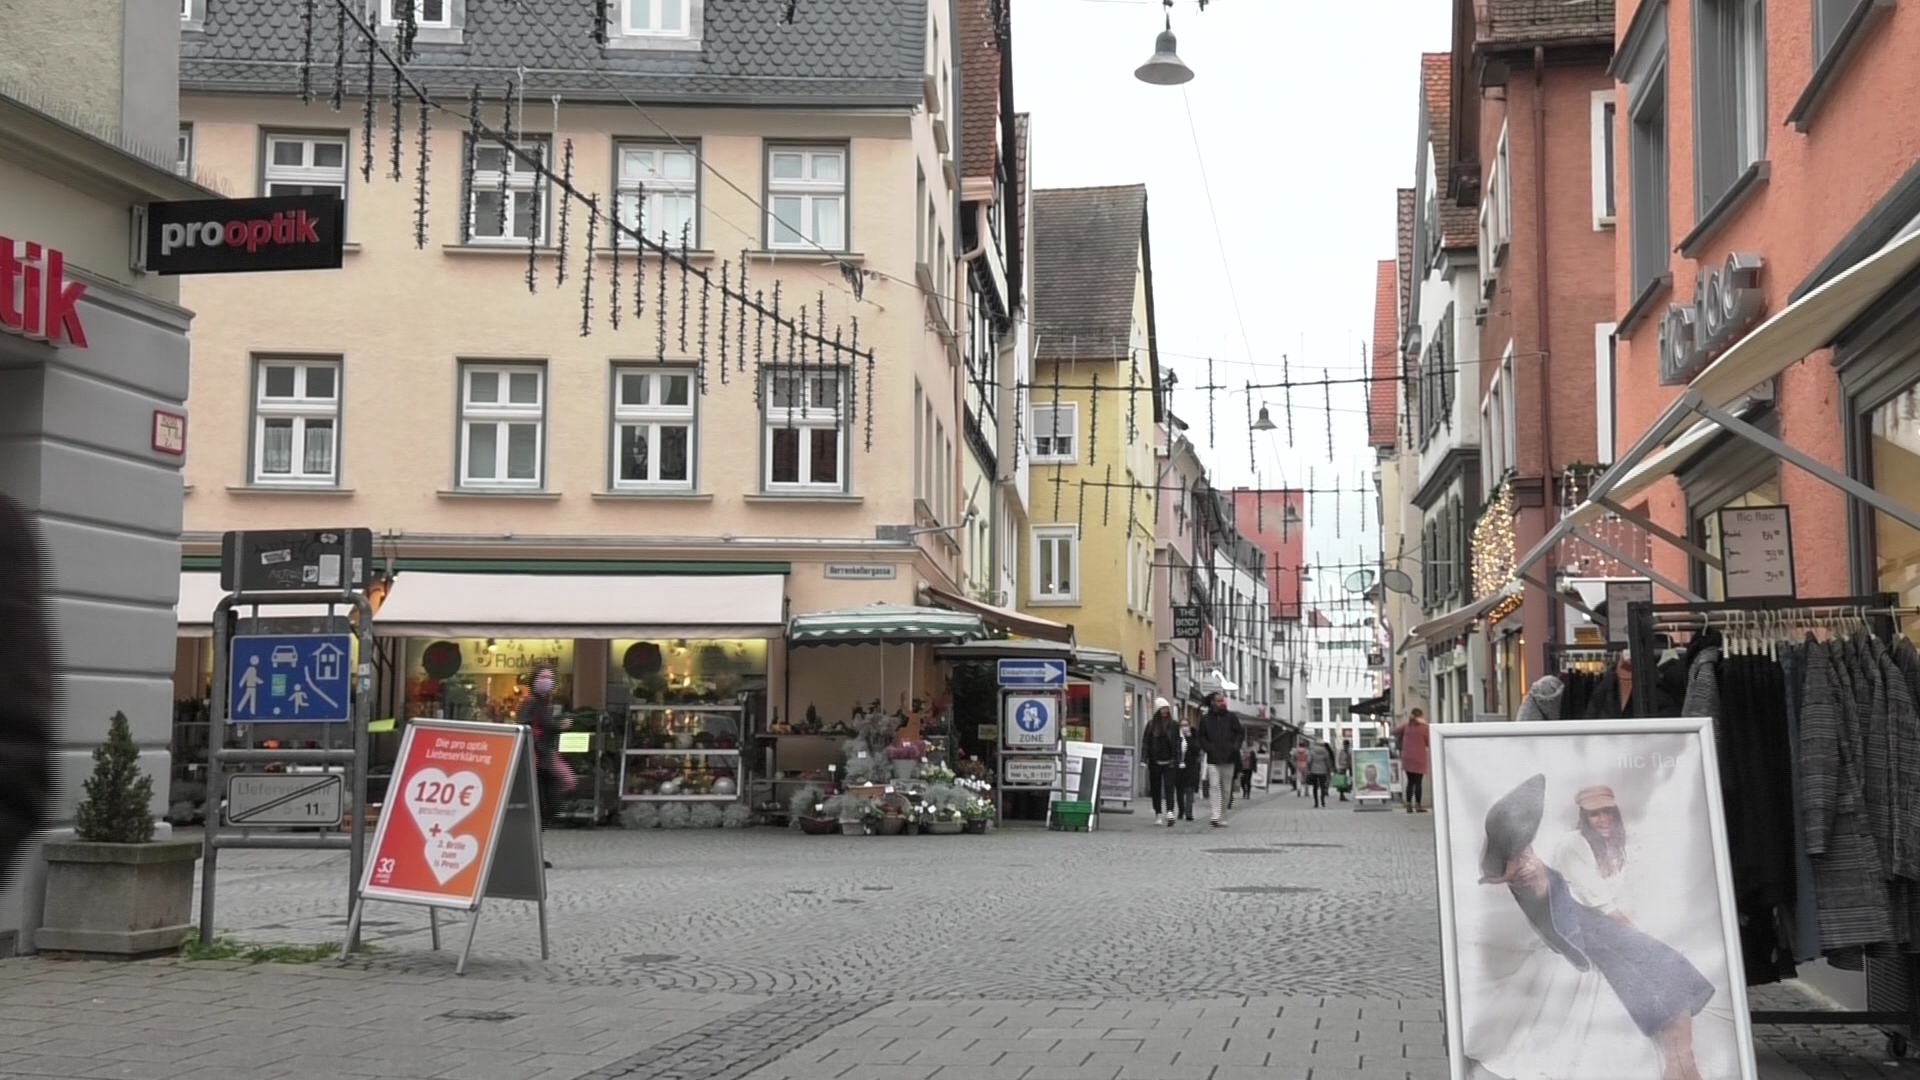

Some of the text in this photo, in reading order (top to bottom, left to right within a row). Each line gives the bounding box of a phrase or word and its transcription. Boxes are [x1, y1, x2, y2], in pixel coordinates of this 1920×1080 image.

[0, 235, 89, 349] tik
[1179, 608, 1197, 617] THE
[1175, 618, 1200, 627] BODY
[1175, 628, 1200, 637] SHOP
[435, 738, 488, 751] Die pro optik
[1019, 733, 1045, 743] ZONE
[425, 748, 492, 765] Liebeserklärung
[414, 781, 456, 805] 120
[377, 858, 395, 873] 33
